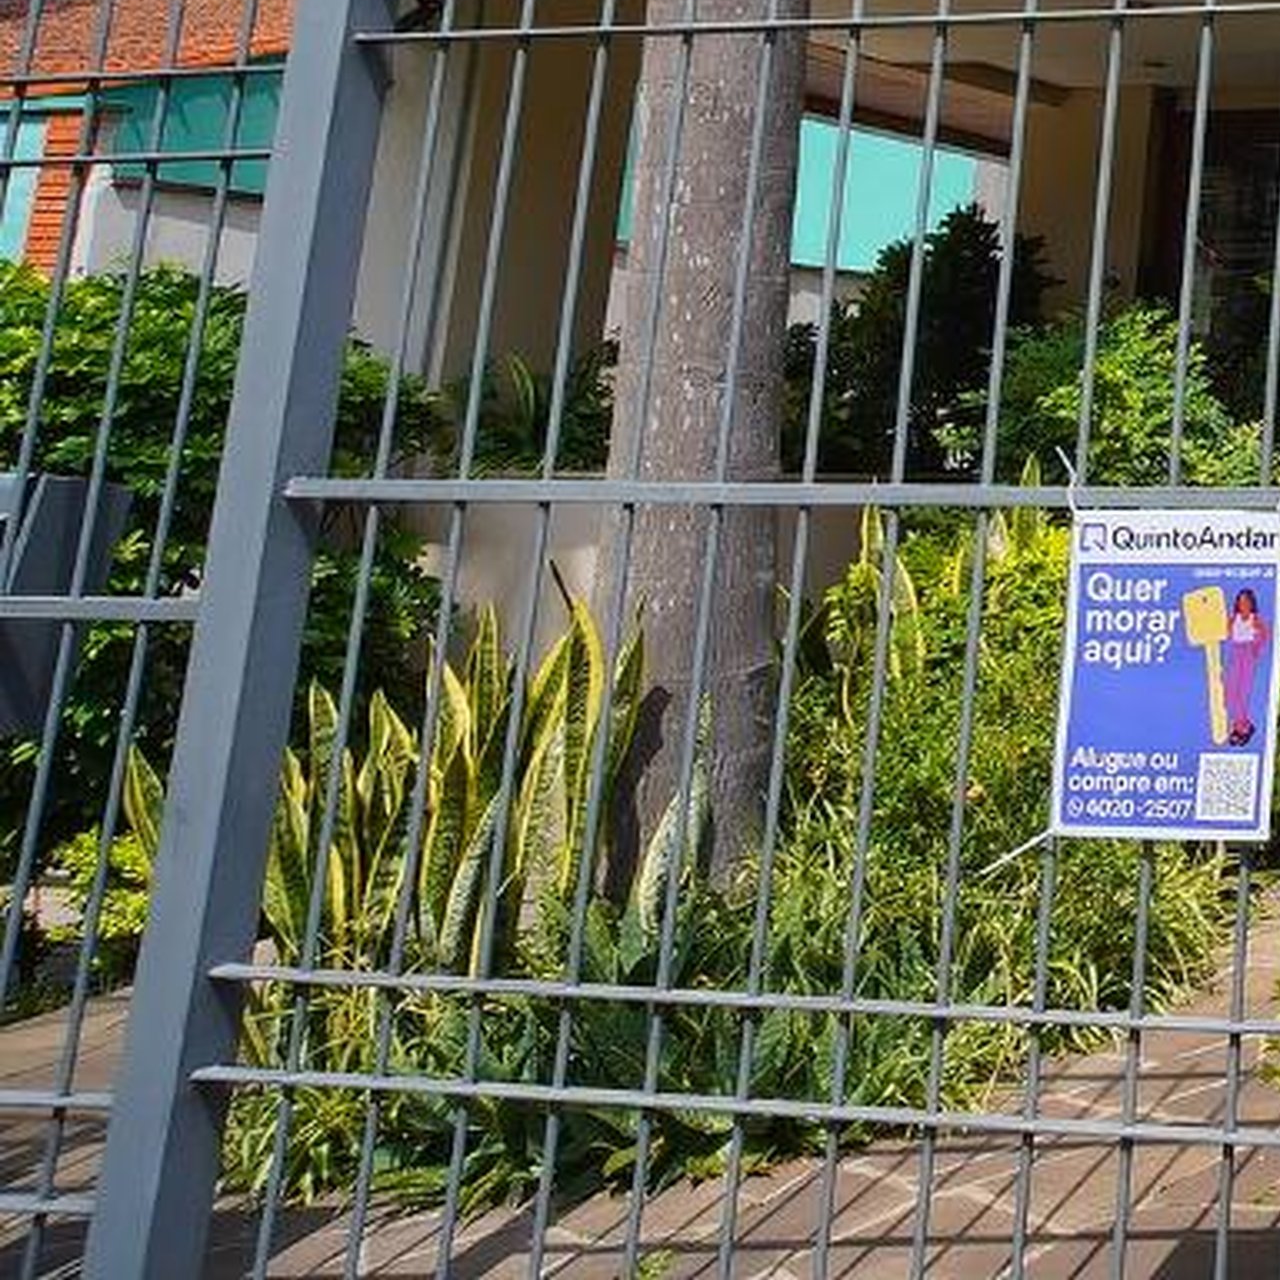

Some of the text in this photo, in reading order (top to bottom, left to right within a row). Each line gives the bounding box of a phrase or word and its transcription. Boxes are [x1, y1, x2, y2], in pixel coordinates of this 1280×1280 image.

[1112, 526, 1278, 553] QuintoAndar
[1087, 572, 1168, 603] Quer
[1085, 609, 1180, 634] morar
[1083, 634, 1171, 670] aqui?
[1070, 746, 1178, 774] Alugue ou
[1068, 774, 1195, 796] compre em:
